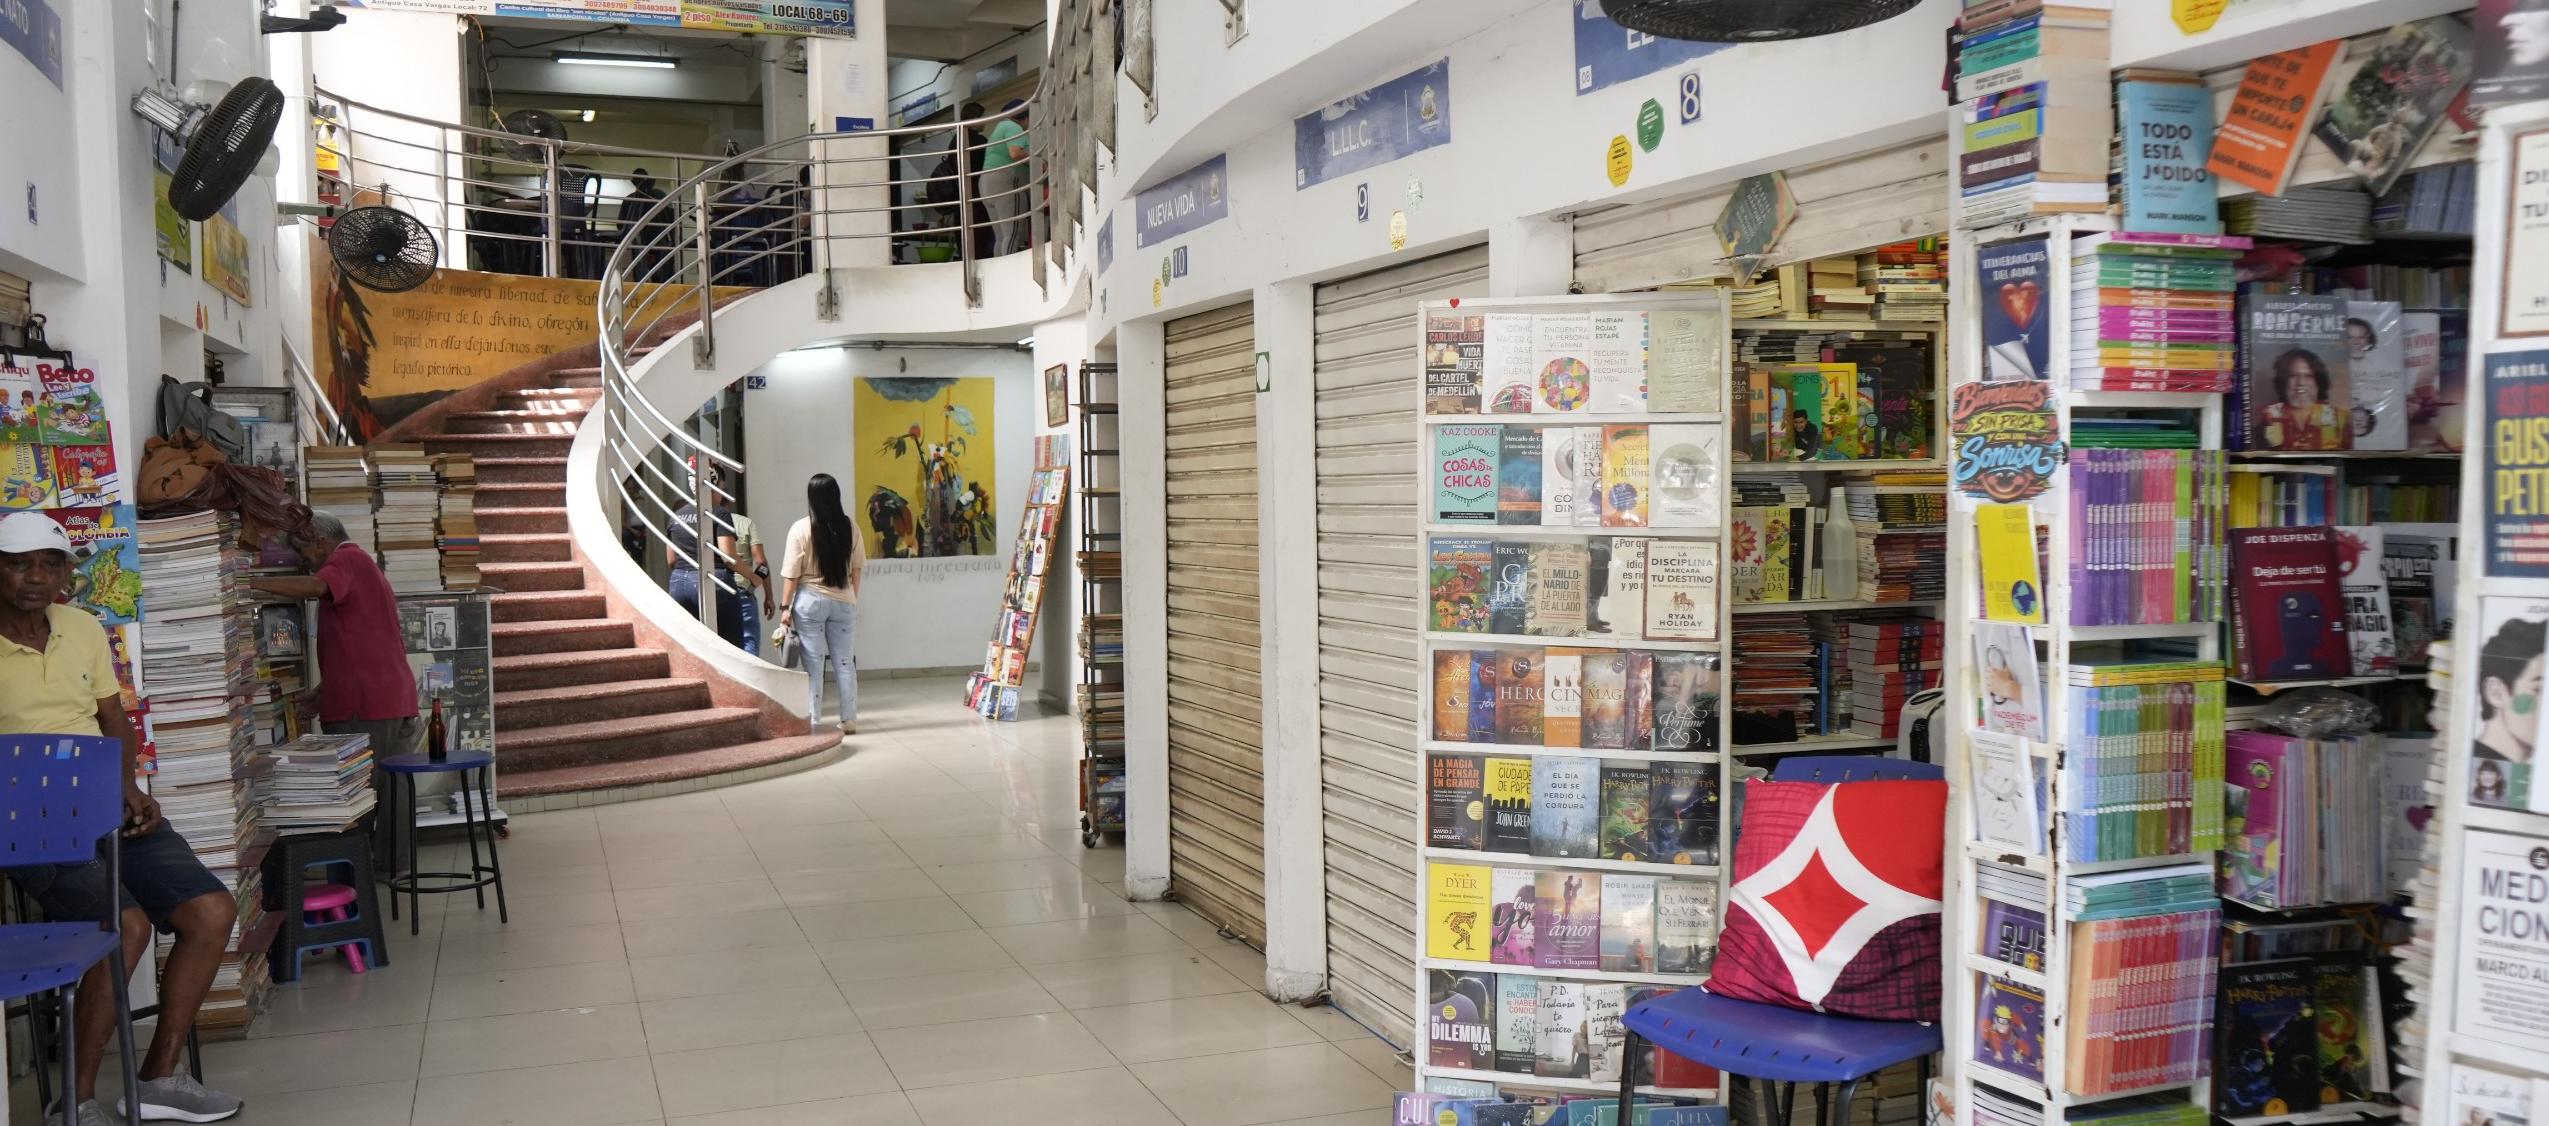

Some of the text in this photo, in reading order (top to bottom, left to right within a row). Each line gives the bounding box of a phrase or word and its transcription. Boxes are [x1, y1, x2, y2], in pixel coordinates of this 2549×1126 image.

[773, 5, 806, 18] LOCAL
[1682, 73, 1699, 120] 8
[2141, 122, 2192, 140] TODO
[2143, 141, 2184, 160] ESTÁ
[1358, 187, 1368, 220] 9
[1147, 191, 1196, 229] NUEVA VIDA
[2147, 213, 2208, 222] MARK MANSON
[1173, 248, 1185, 276] 10
[553, 292, 570, 305] de
[456, 309, 470, 323] de
[2252, 311, 2348, 332] ROMPERME
[1429, 332, 1458, 342] CARLOS
[1463, 347, 1481, 357] VIDA
[748, 376, 766, 389] 42
[1428, 373, 1469, 383] DEL CARTEL
[1428, 388, 1437, 396] DE
[1973, 414, 2034, 432] SIN PRISA
[1441, 428, 1497, 436] KAZ COOKE
[1955, 436, 2056, 481] Sonrisa
[1442, 458, 1486, 473] COSAS
[1444, 474, 1491, 488] CHICAS
[66, 515, 99, 529] Atlas de
[67, 526, 131, 541] OLOMBIA
[2244, 533, 2327, 544] JOE DISPENZA
[1614, 539, 1634, 549] ¿Por
[1496, 547, 1516, 555] ERIC
[1651, 558, 1713, 567] DISCIPLINA
[1502, 563, 1521, 585] G
[1553, 569, 1582, 579] MILLO-
[2252, 564, 2327, 578] Deja de ser tú
[1651, 574, 1713, 583] TU DESTINO
[1543, 580, 1581, 590] NARIO DE
[1629, 583, 1638, 591] yo
[1543, 591, 1581, 601] LA PUERTA
[1434, 759, 1473, 769] LA MAGIA
[1434, 768, 1479, 779] DE PENSAR
[1565, 771, 1579, 779] DÍA
[1434, 778, 1480, 788] EN GRANDE
[1498, 781, 1508, 791] DE
[1545, 802, 1585, 810] CORDURA
[1446, 878, 1477, 889] DYER
[1664, 894, 1676, 904] EL
[1552, 908, 1562, 925] 5
[1679, 920, 1710, 928] FERRARI
[1549, 925, 1597, 938] amor
[1545, 958, 1597, 967] Gary Chapman
[2477, 957, 2530, 981] MARCO
[1551, 985, 1569, 996] P.D.
[1542, 998, 1576, 1009] Todavía
[1596, 1000, 1619, 1010] Para
[1432, 1015, 1440, 1023] MY
[1553, 1012, 1563, 1021] te
[1431, 1023, 1492, 1043] DILEMMA
[1544, 1023, 1573, 1037] quiero
[1472, 1043, 1479, 1051] IS
[1434, 1084, 1487, 1098] HISTORIA
